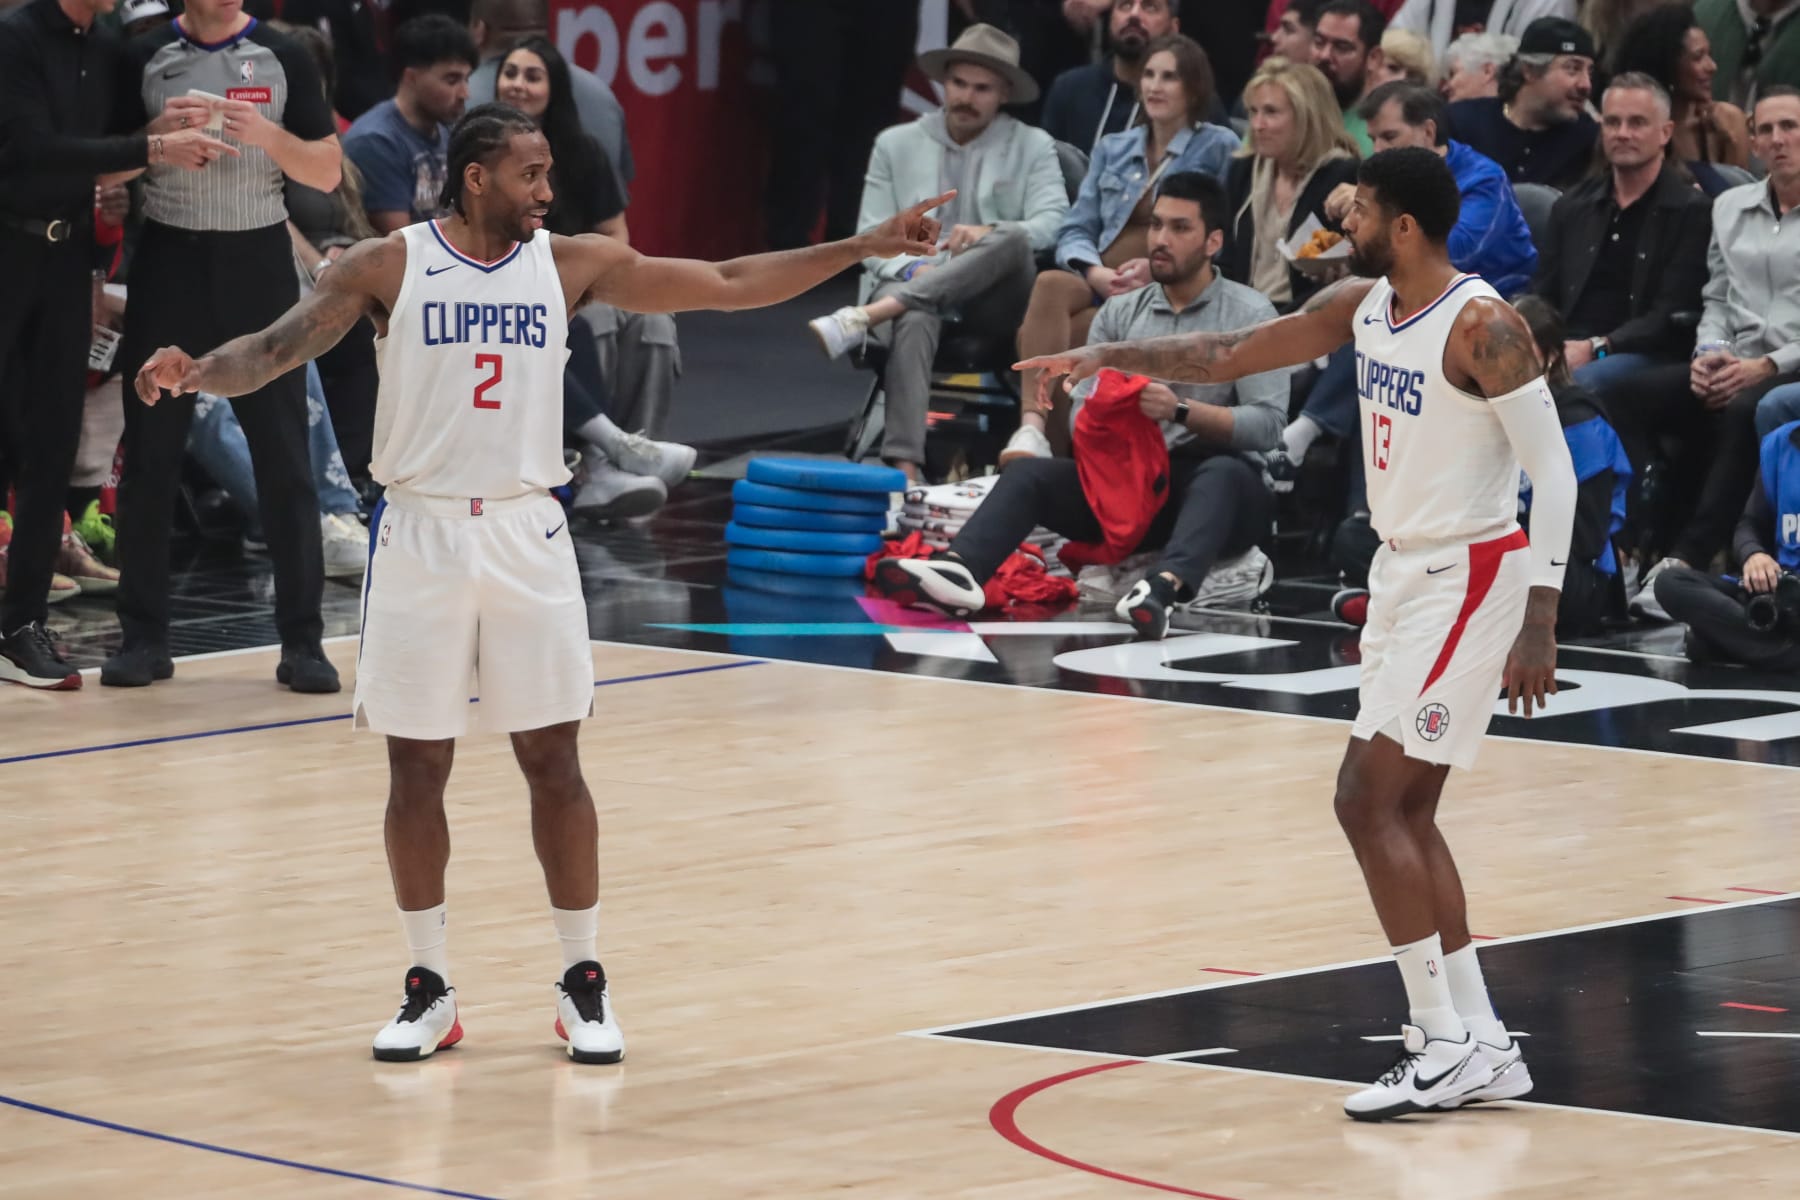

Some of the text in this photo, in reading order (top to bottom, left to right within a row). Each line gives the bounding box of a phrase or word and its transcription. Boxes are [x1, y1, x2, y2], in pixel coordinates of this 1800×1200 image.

[230, 91, 268, 101] Emirates
[422, 301, 547, 348] CLIPPERS
[473, 352, 503, 410] 2
[1372, 412, 1392, 471] 13
